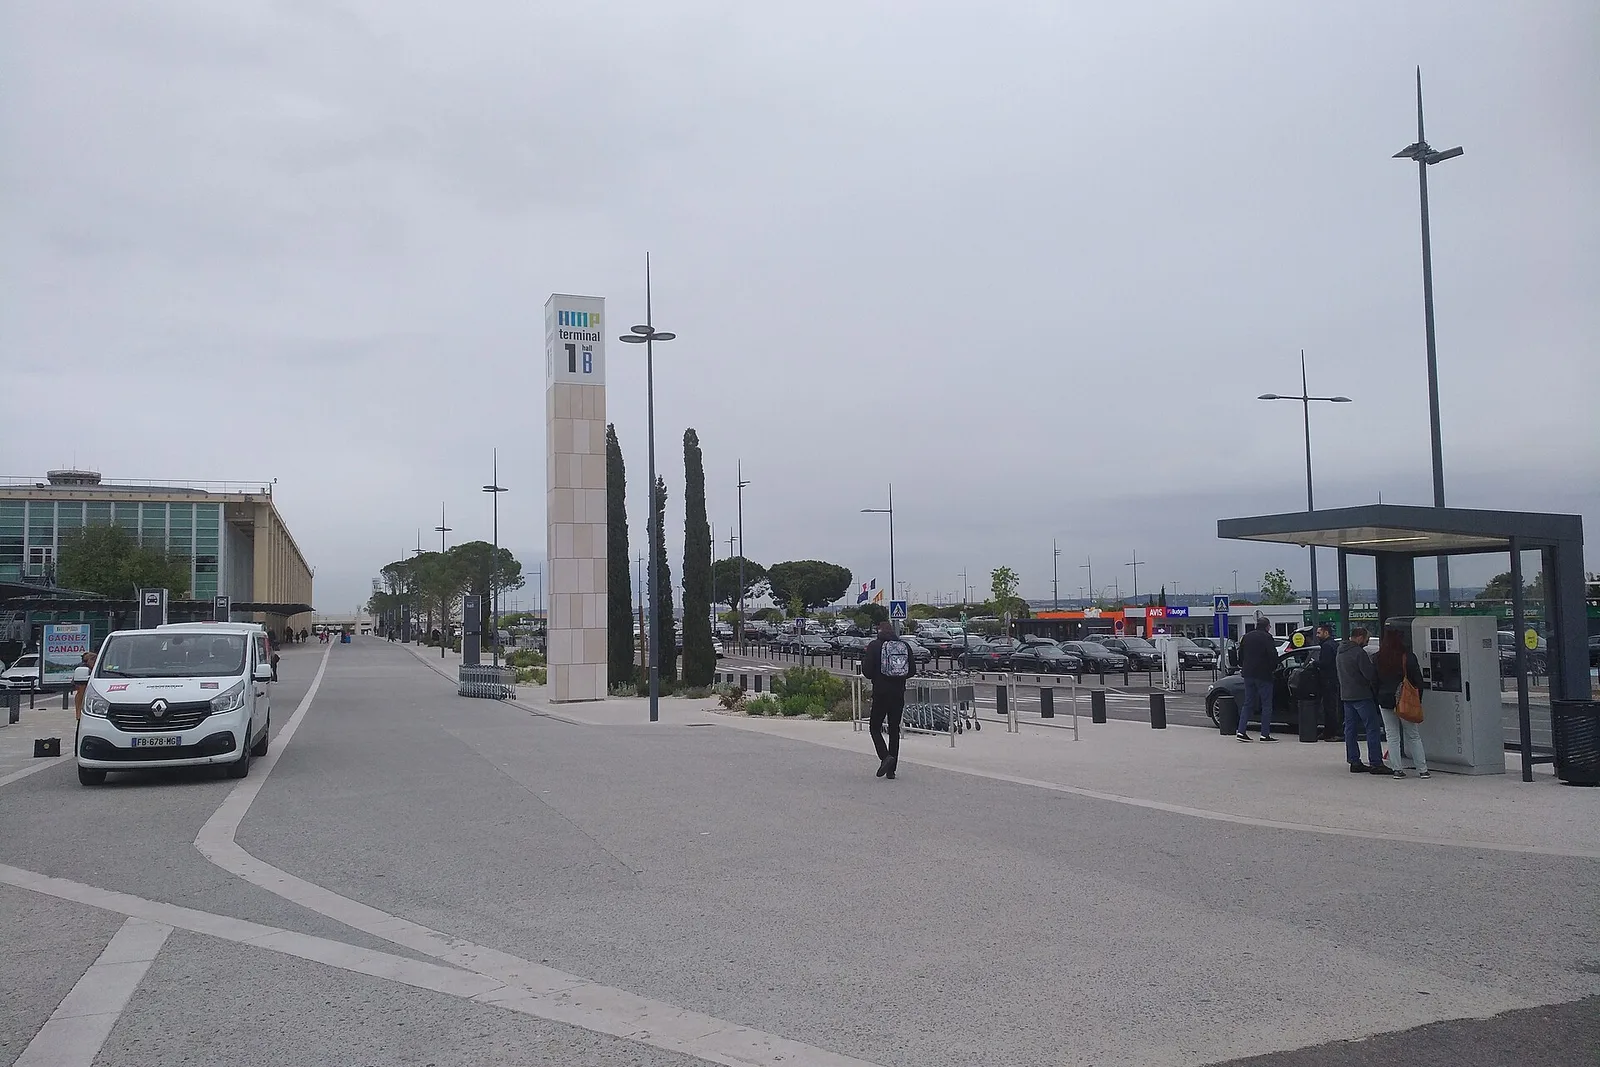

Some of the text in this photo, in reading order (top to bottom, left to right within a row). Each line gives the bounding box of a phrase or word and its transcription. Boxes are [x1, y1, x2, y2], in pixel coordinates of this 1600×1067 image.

[559, 329, 600, 341] terminal
[564, 343, 576, 373] 1
[582, 352, 593, 374] B
[1149, 609, 1163, 617] AVIS
[1171, 608, 1187, 617] Budget
[48, 634, 87, 642] GAGNEZ
[48, 645, 86, 653] CANADA
